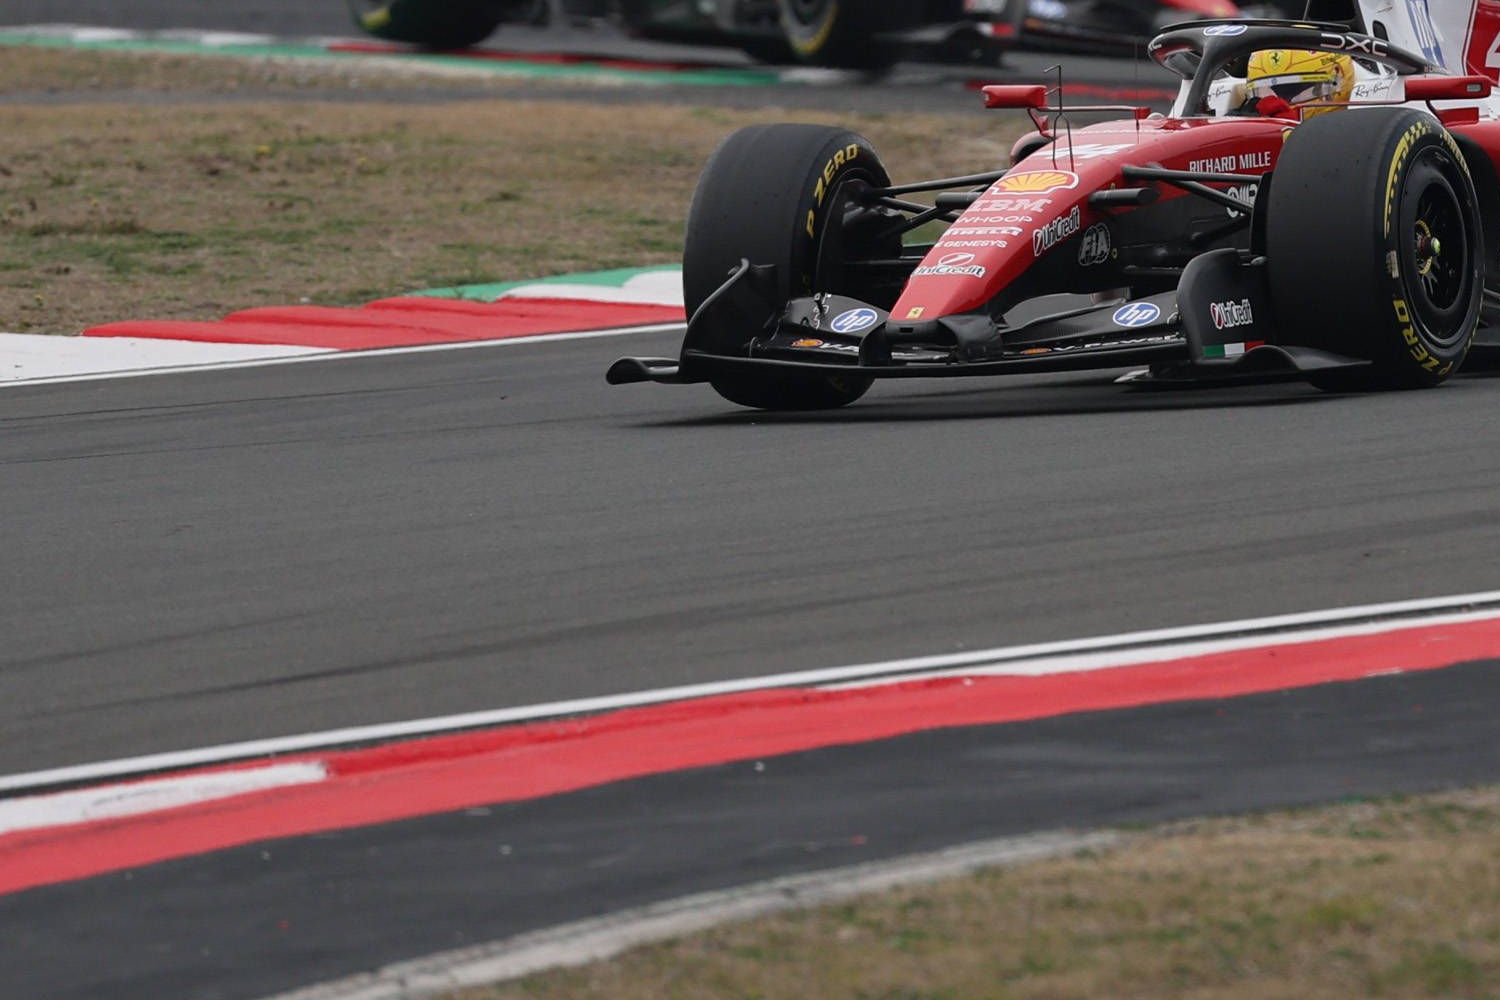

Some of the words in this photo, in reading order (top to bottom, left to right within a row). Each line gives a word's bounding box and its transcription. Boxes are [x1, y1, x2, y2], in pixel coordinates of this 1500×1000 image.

[1320, 33, 1389, 57] DXC
[1353, 83, 1391, 98] Ray-Ban
[1189, 155, 1236, 174] RICHARD
[1238, 151, 1271, 169] MILLE
[814, 143, 859, 207] ZERO
[967, 199, 1053, 214] IBM
[1043, 205, 1081, 251] UniCredit
[943, 238, 1009, 249] GENESYS
[1081, 229, 1110, 262] FIA
[1117, 303, 1155, 325] hp
[1393, 299, 1440, 372] ZERO
